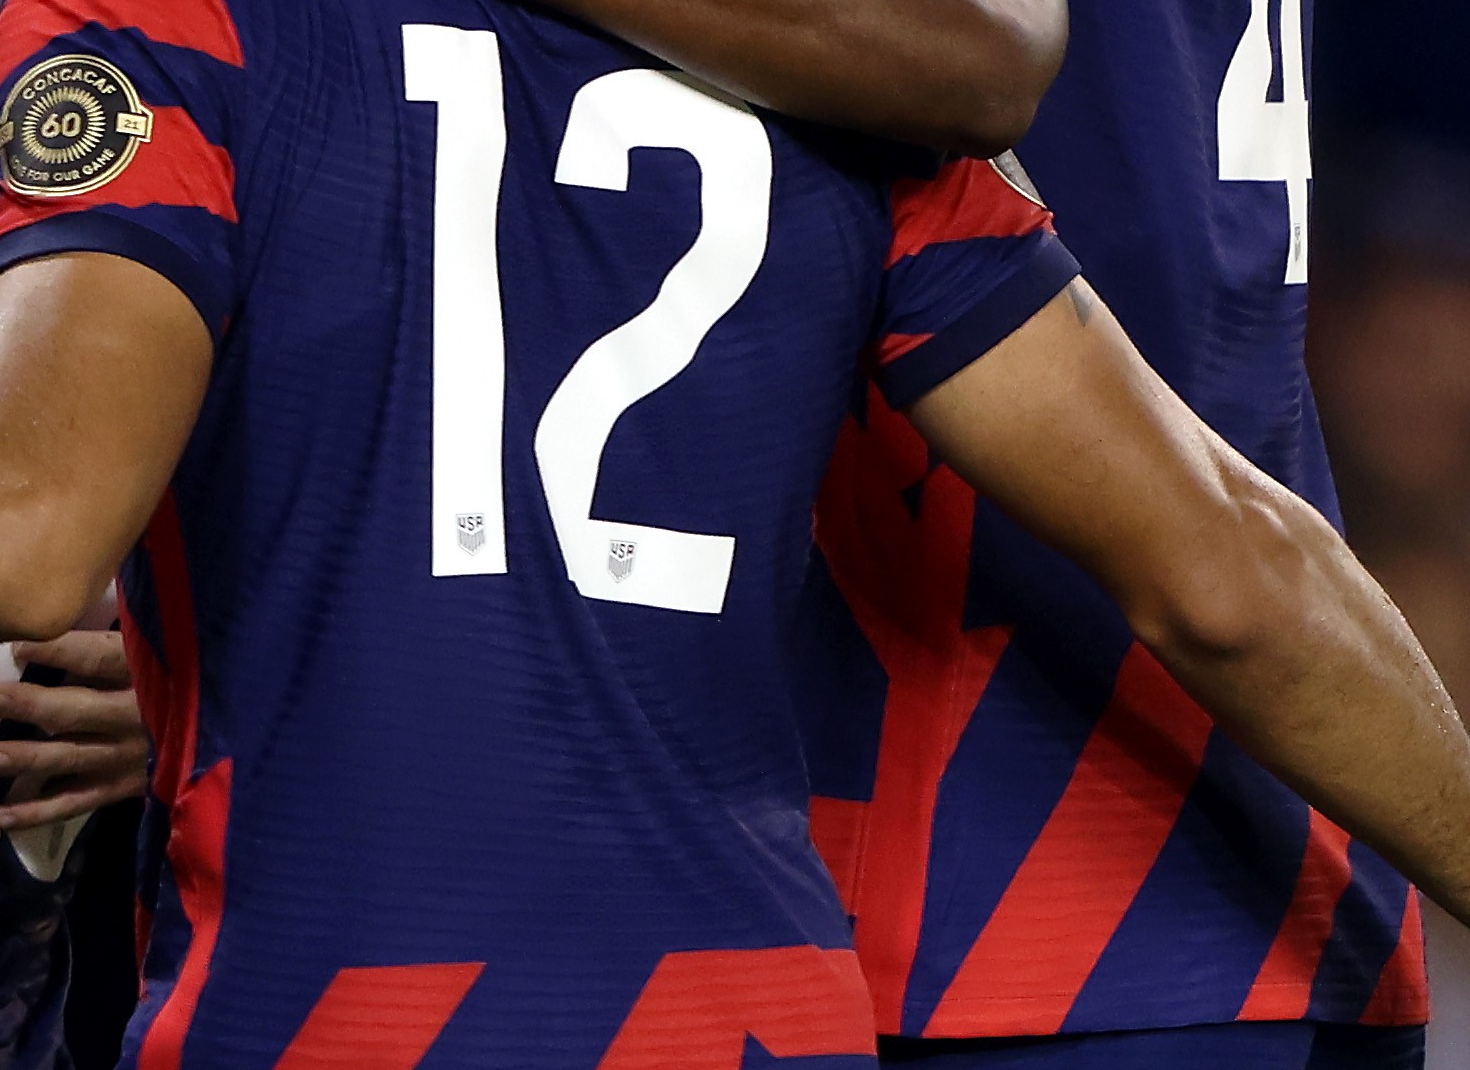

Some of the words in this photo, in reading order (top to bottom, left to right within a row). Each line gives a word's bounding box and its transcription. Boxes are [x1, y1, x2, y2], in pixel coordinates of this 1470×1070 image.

[21, 68, 117, 100] CONCACAF
[40, 112, 82, 139] 60
[124, 119, 139, 130] 21
[27, 170, 50, 181] FOR
[52, 170, 81, 181] OUR
[81, 148, 116, 175] GAME
[401, 23, 774, 614] 12
